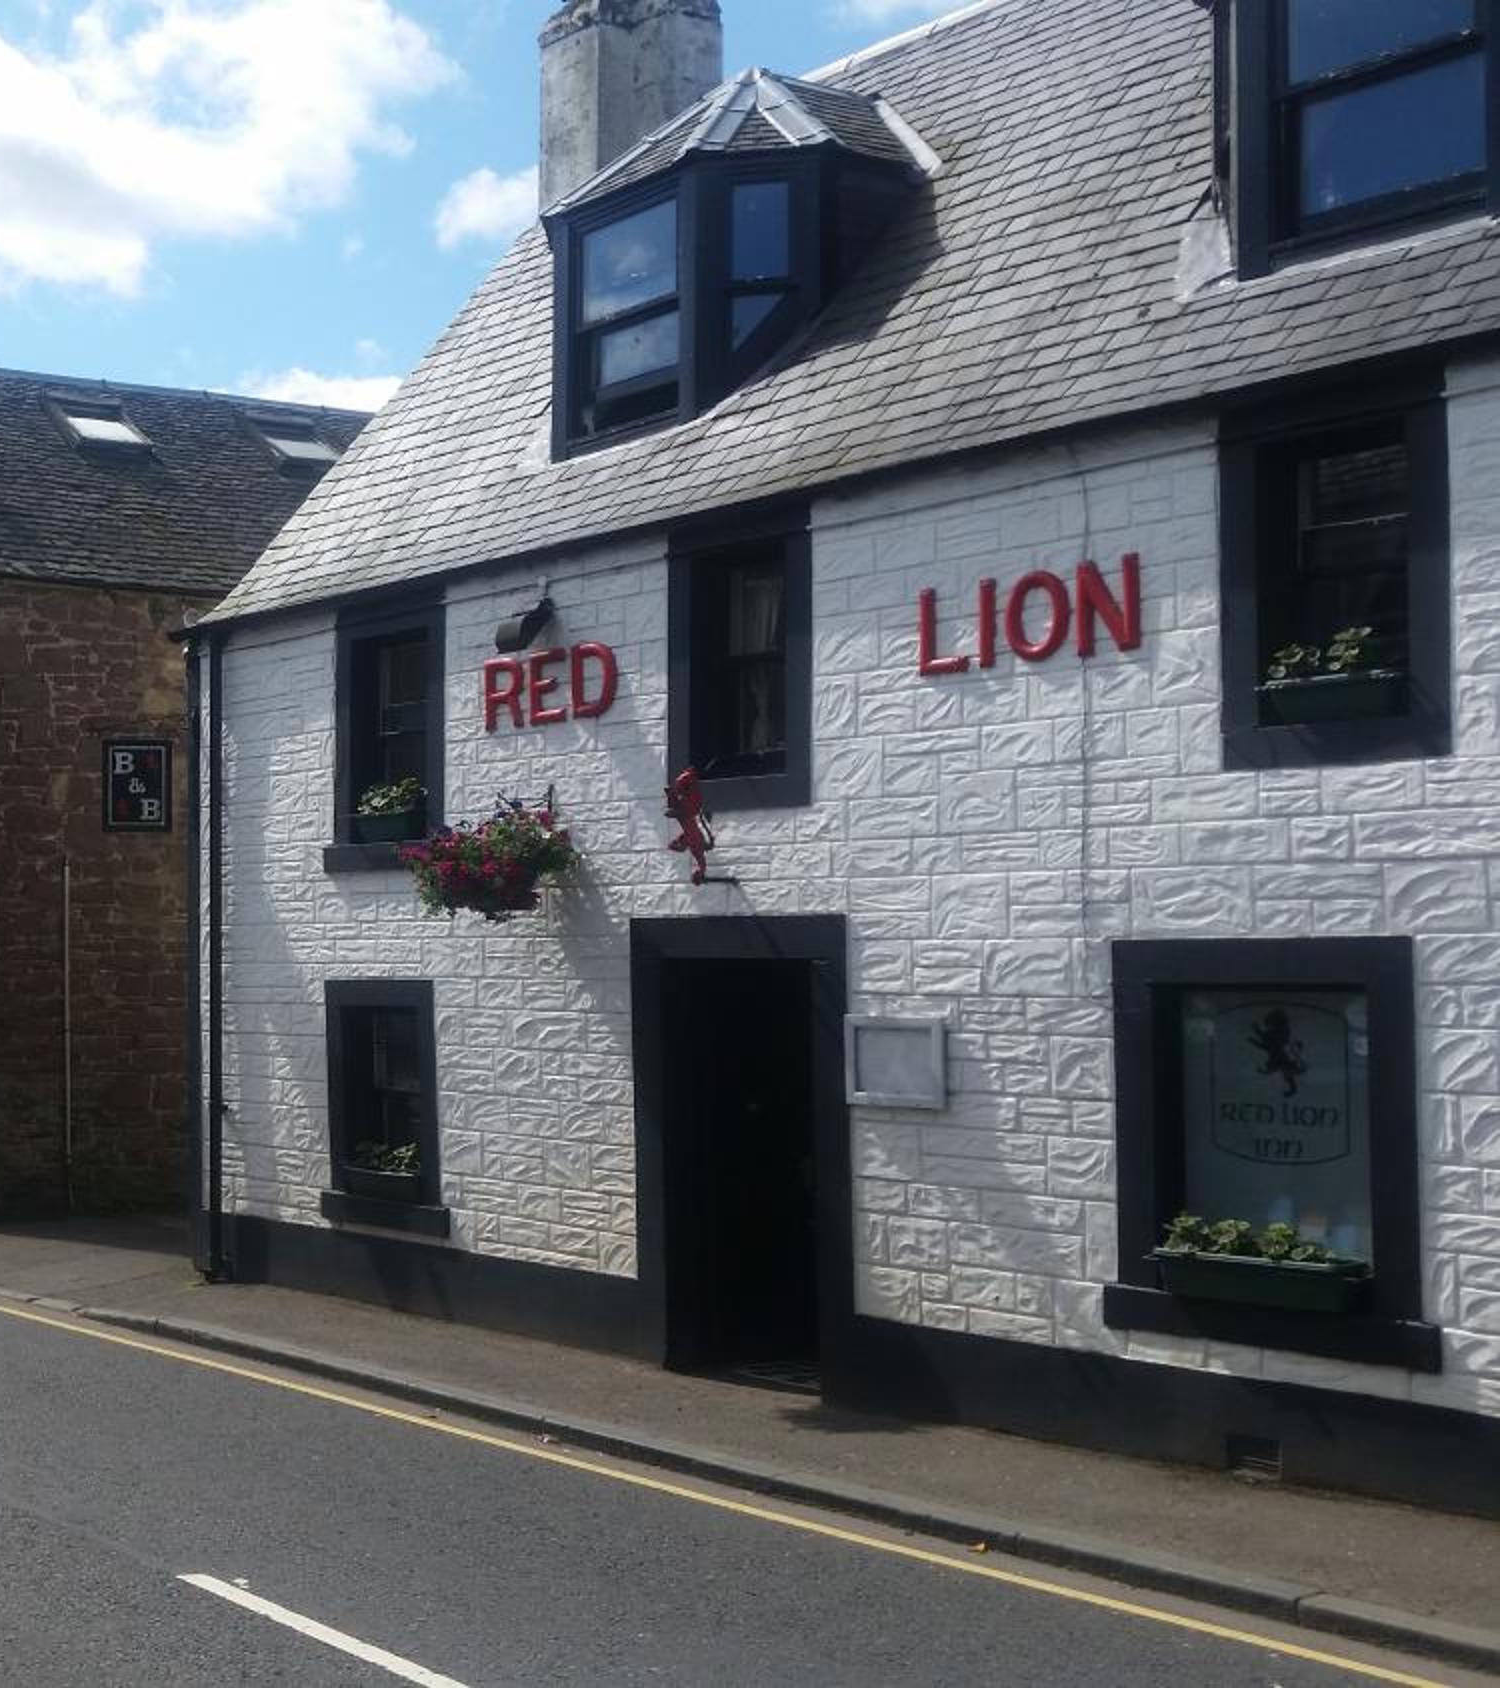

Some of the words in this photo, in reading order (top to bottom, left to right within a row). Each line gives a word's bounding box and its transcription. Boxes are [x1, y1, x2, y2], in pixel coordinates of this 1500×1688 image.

[482, 639, 619, 732] RED
[917, 552, 1142, 676] LION
[113, 751, 135, 775] B
[128, 777, 146, 793] &
[140, 798, 160, 820] B
[1220, 1103, 1275, 1124] RED
